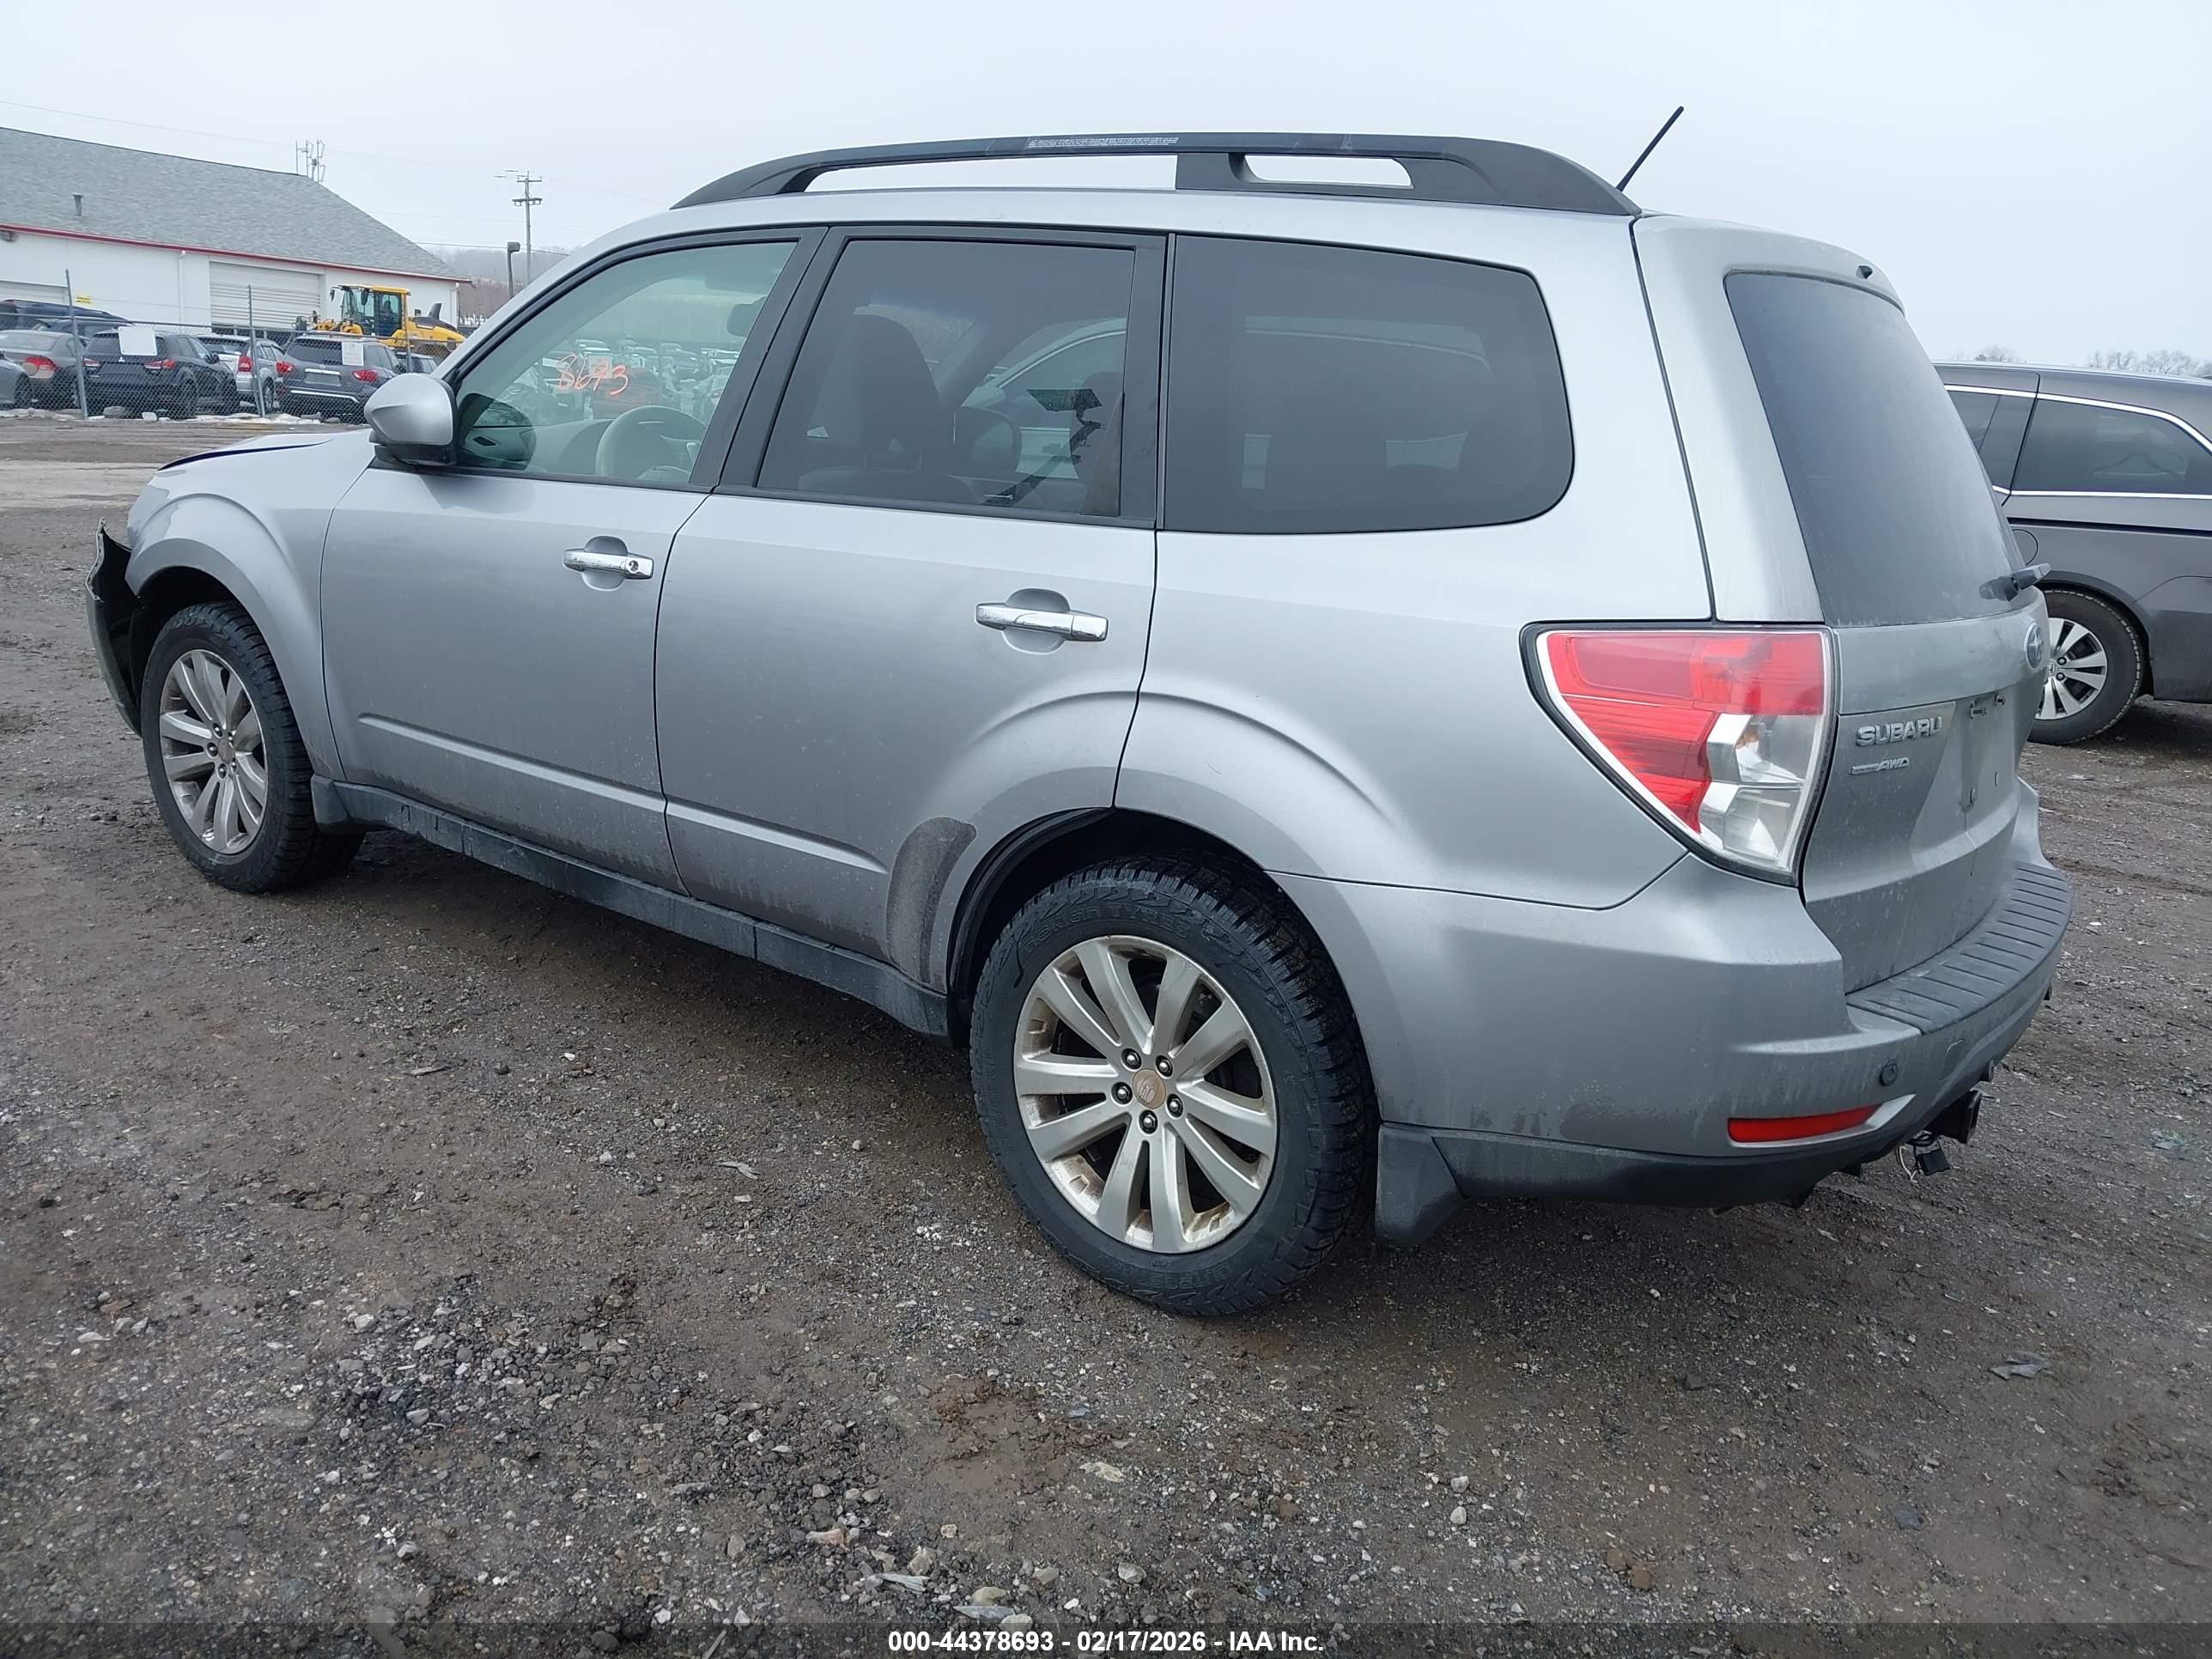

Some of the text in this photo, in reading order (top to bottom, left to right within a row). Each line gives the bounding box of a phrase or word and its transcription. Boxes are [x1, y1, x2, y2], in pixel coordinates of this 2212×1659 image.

[556, 353, 629, 396] 8693
[1856, 716, 1943, 746] SUBARU
[1876, 757, 1911, 771] AWD
